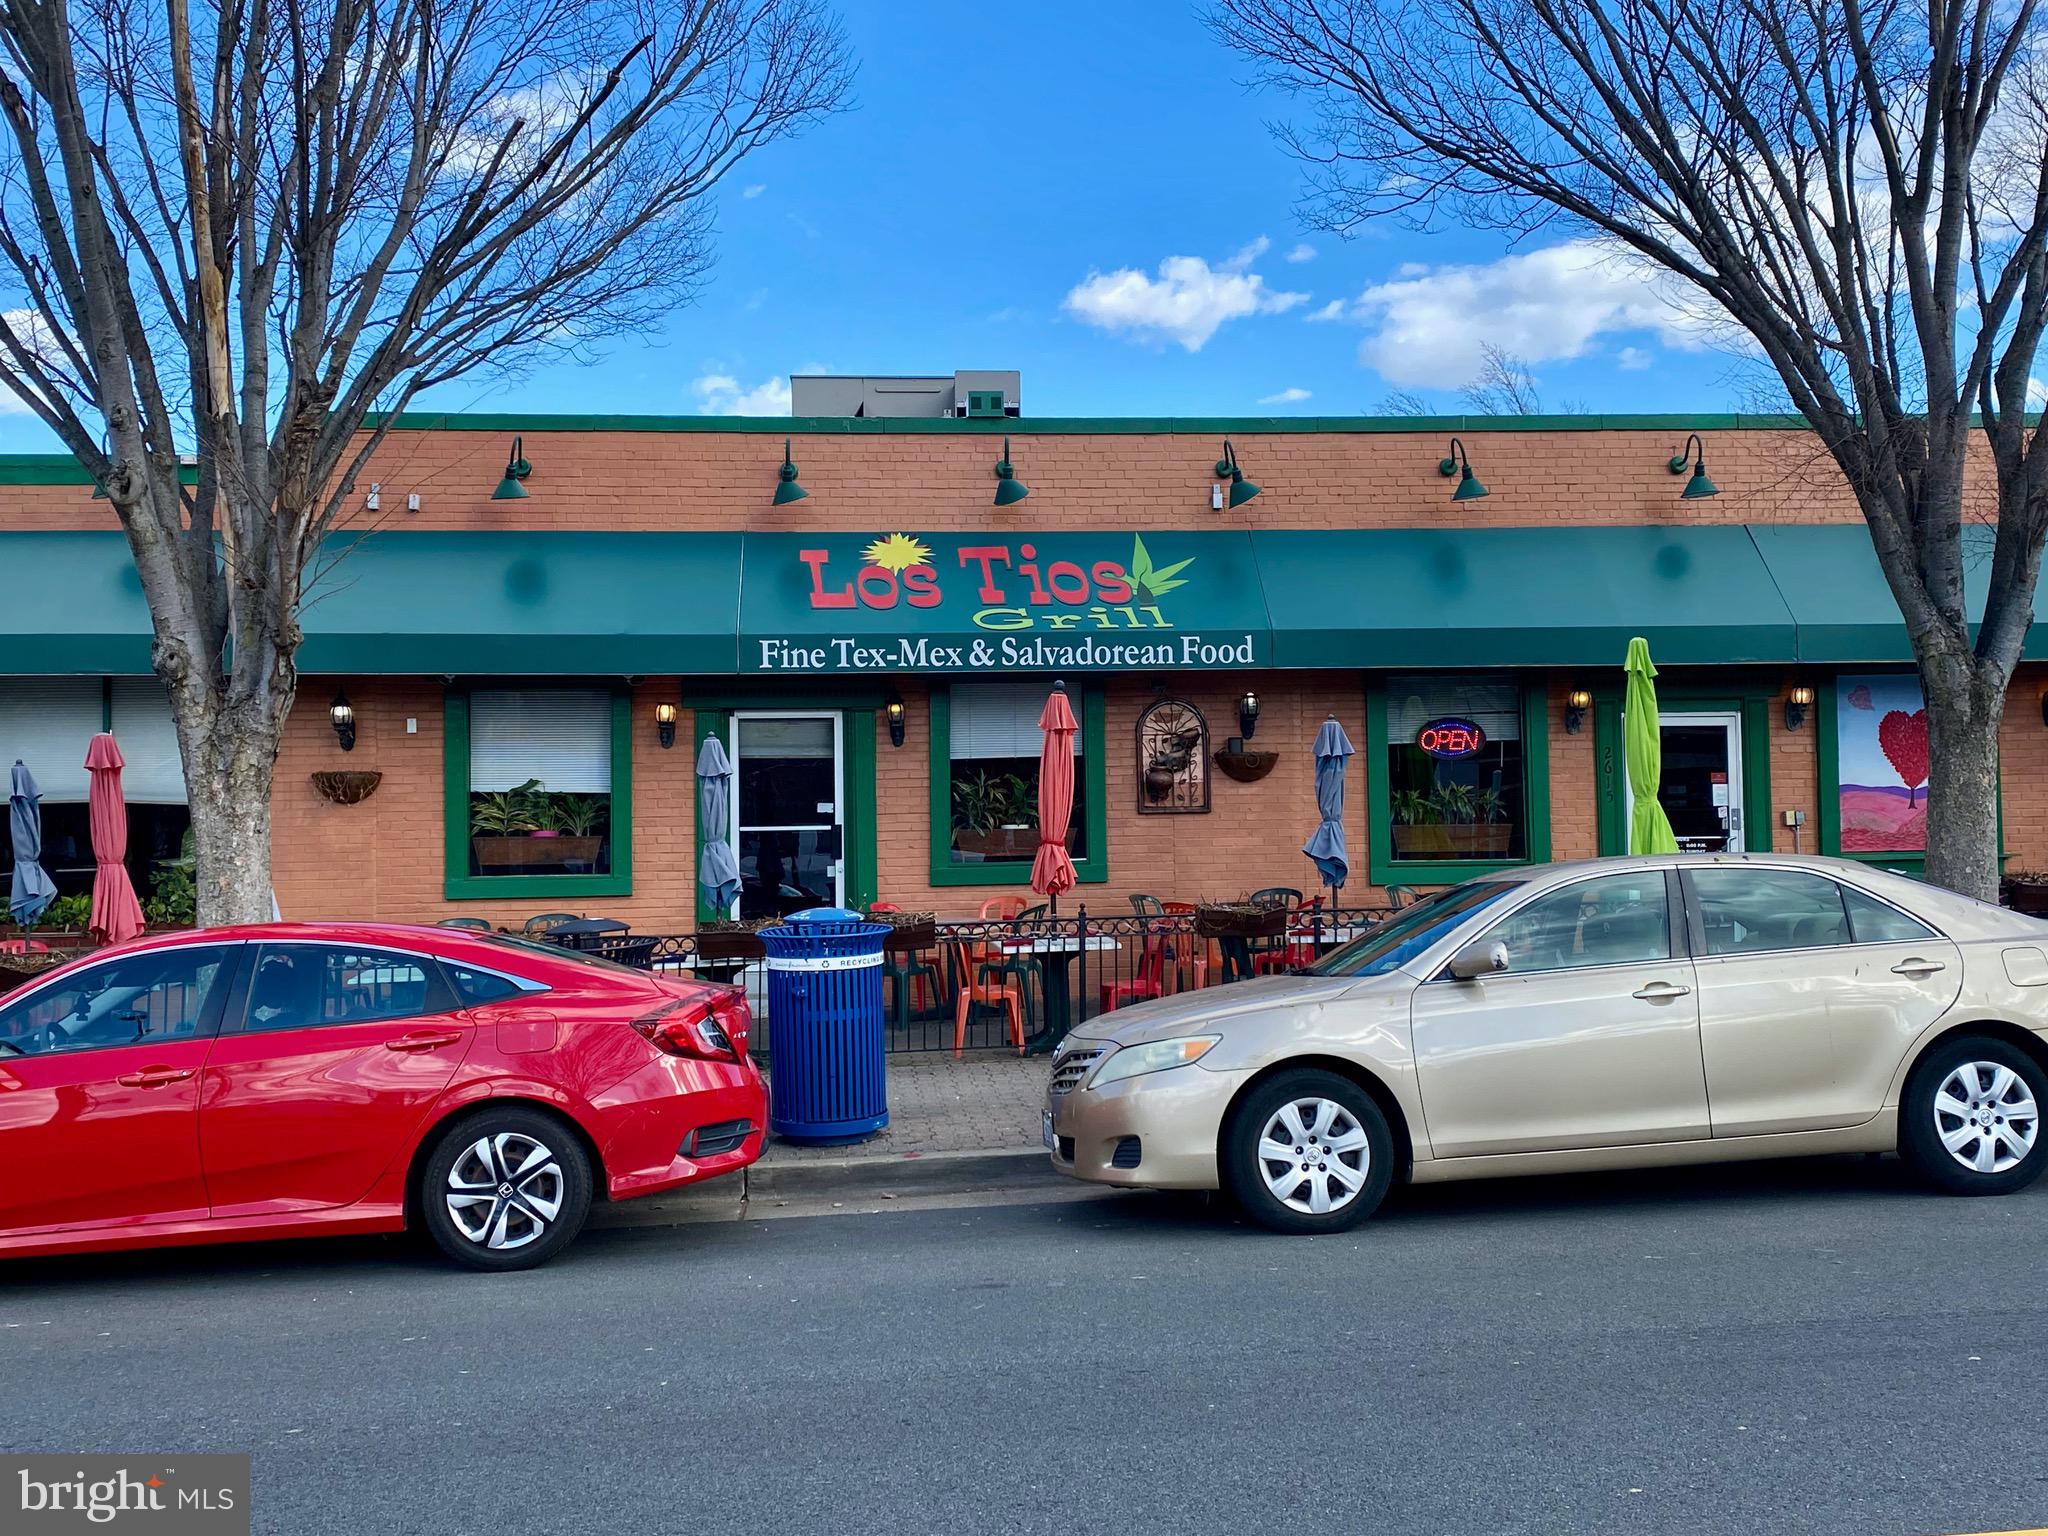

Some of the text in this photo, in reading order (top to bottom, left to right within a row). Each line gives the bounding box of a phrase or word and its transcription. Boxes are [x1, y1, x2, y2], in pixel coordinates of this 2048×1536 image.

[799, 543, 1133, 609] Los Tios
[972, 606, 1174, 630] Grill
[759, 634, 1255, 668] Fine Tex-Mex & Salvadorean Food
[1421, 730, 1479, 750] OPEN
